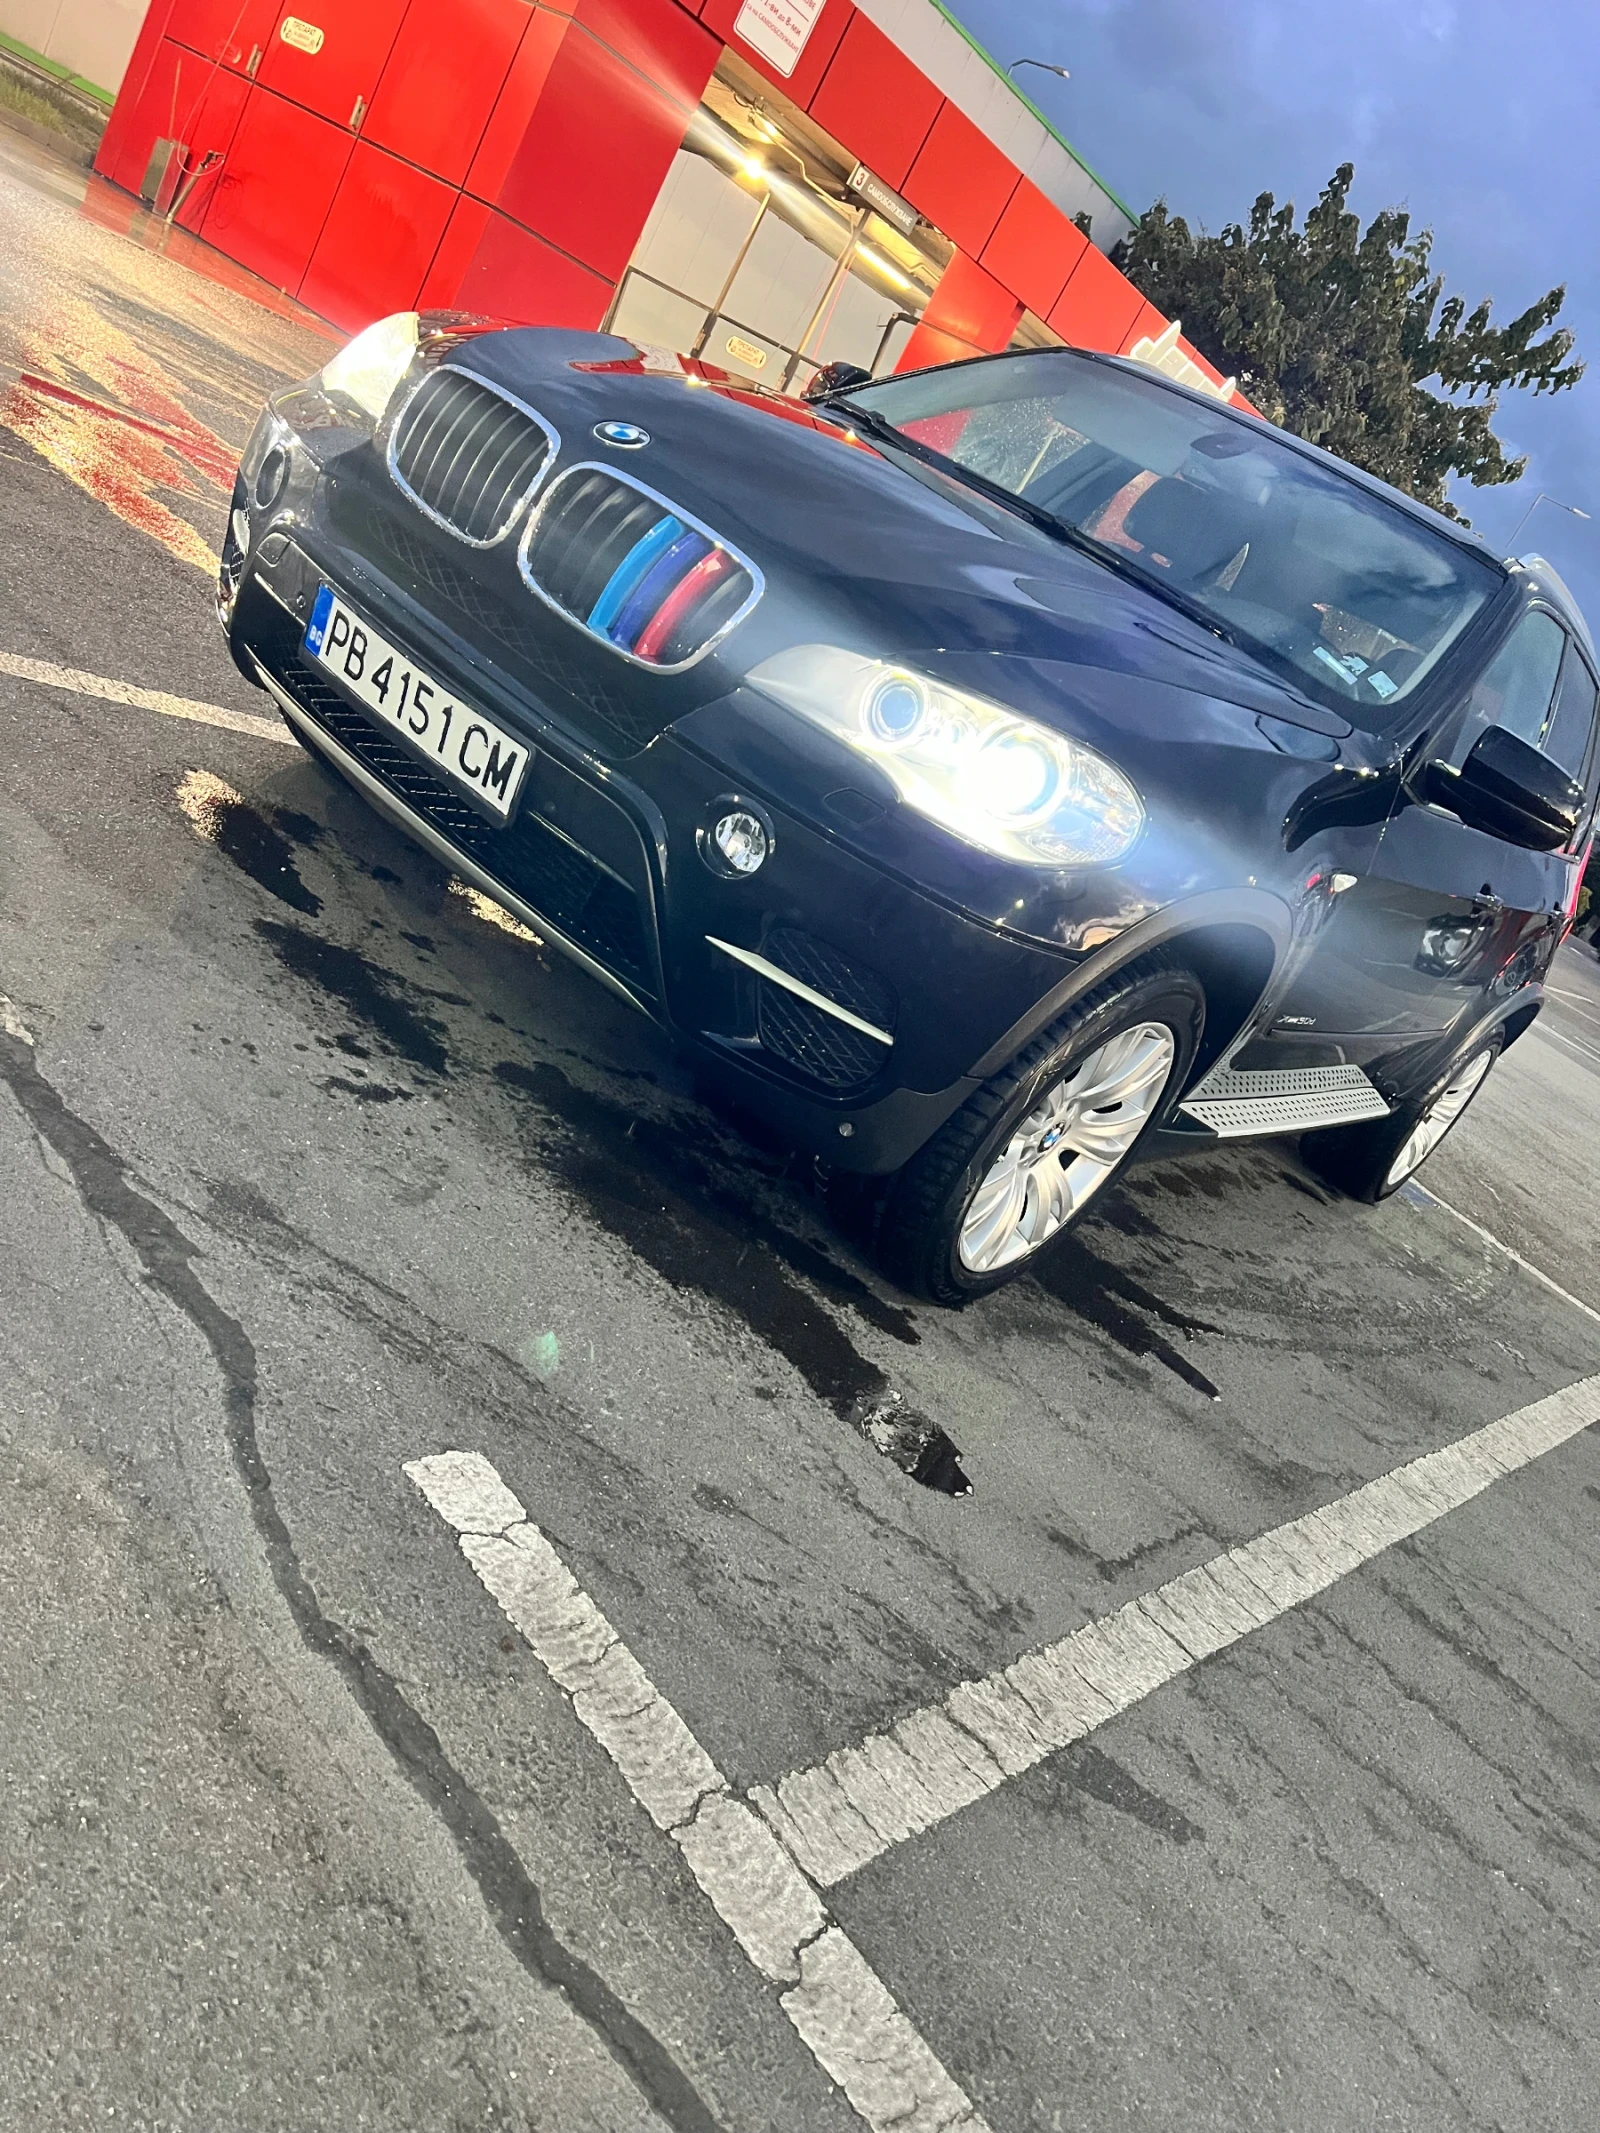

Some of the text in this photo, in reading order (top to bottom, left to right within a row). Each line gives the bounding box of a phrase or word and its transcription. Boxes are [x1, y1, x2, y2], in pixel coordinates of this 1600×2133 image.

[856, 172, 866, 187] 3
[309, 624, 322, 646] BG
[371, 656, 453, 753] 4151
